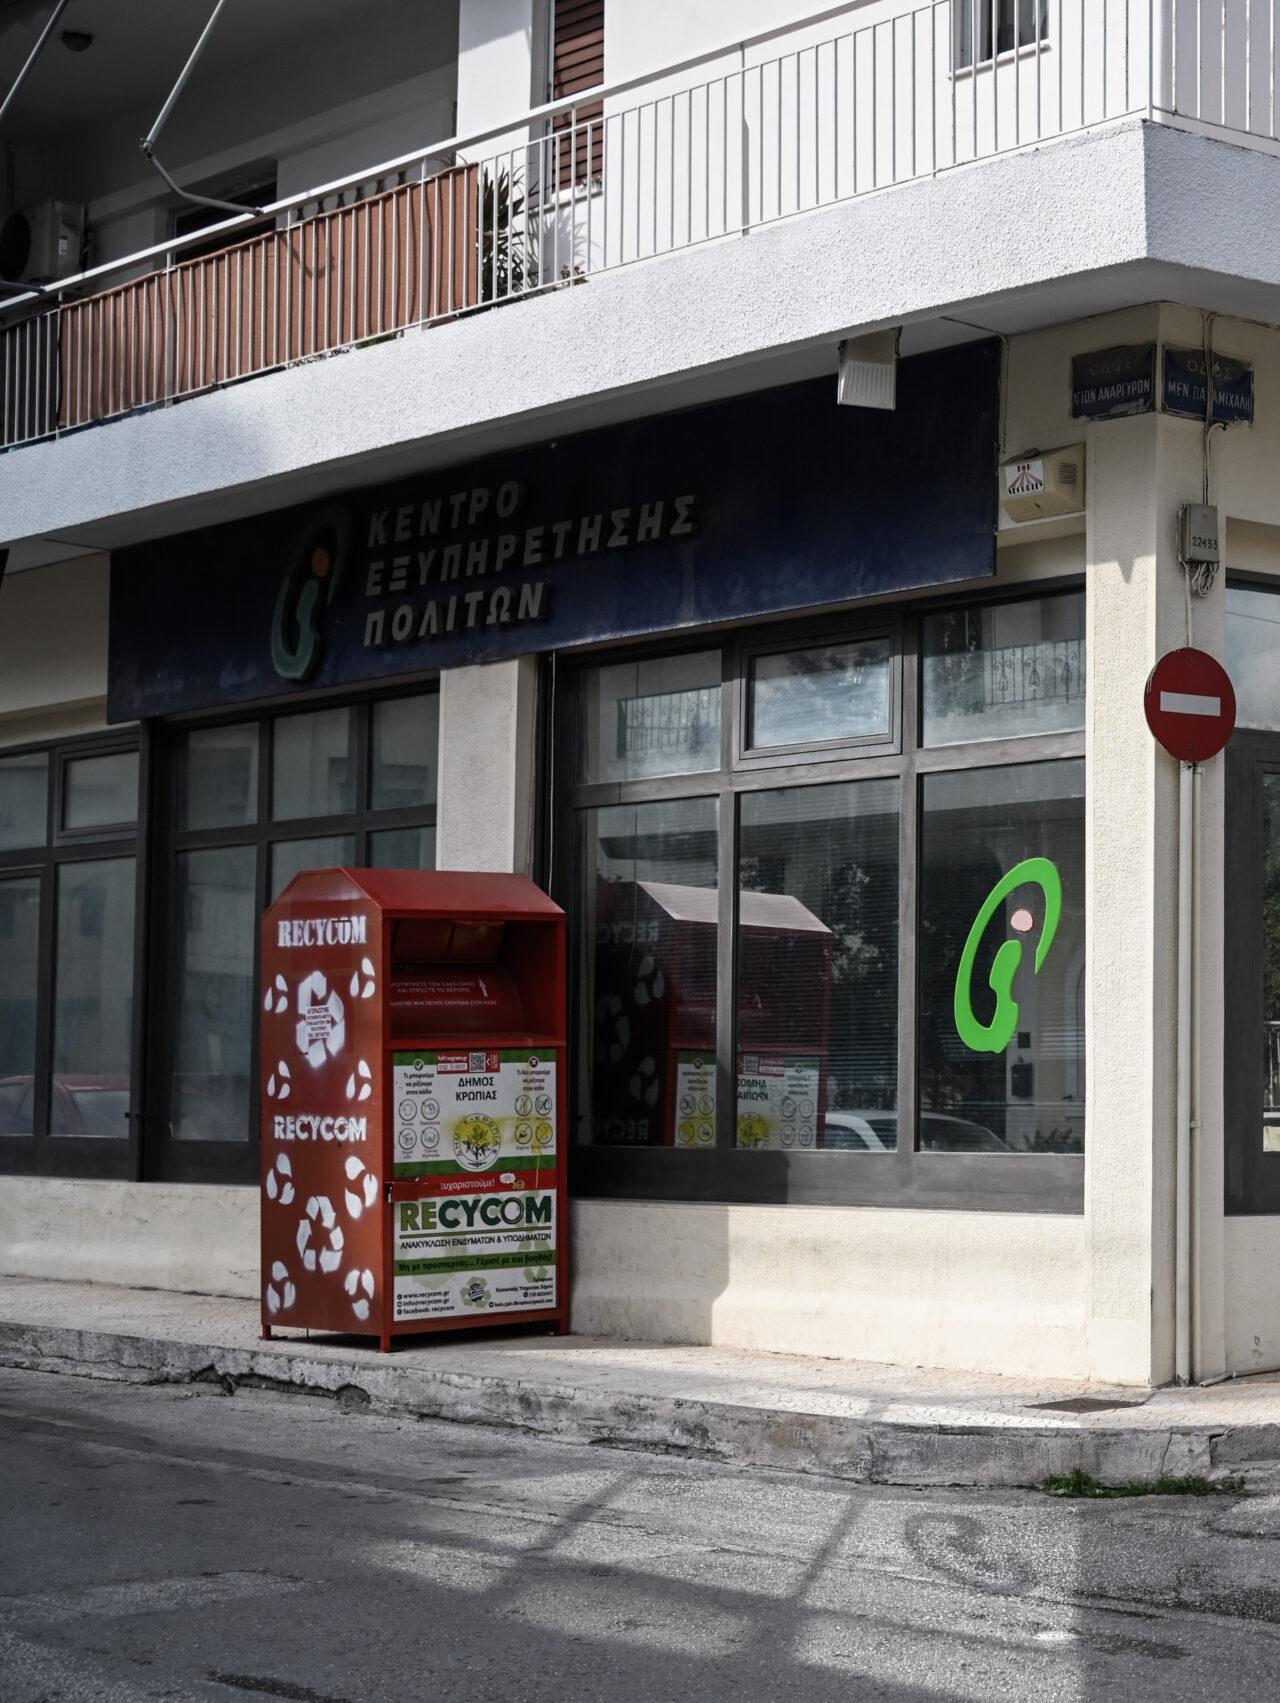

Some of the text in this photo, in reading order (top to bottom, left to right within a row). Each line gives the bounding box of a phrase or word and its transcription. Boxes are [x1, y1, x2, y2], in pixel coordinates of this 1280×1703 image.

[1098, 378, 1150, 401] ΑΝΑΡΓΥΡΩΝ
[1193, 385, 1250, 412] ΠΑΑΜΙΧΑΛΗ
[1008, 482, 1043, 495] SECURITY
[367, 480, 520, 548] ΚΕΝΤΡΟ
[365, 494, 696, 597] ΕΞΥΠΗΡΕΤΗΣΗΣ
[363, 581, 544, 647] ΠΟΛΙΤΩΝ
[277, 915, 367, 947] RECYCOM
[458, 1076, 495, 1088] ΔΗΜΟΣ
[456, 1090, 497, 1101] ΚΡΩΠΙΑΣ
[274, 1115, 367, 1142] RECYCOM
[400, 1195, 552, 1231] RECYCOM
[400, 1239, 451, 1249] ΑΝΑΚΥΚΛΩΣΗ
[452, 1236, 496, 1246] ΕΝΔΥΜΑΤΩΝ
[503, 1232, 552, 1243] ΥΠΟΔΗΜΑΤΩΝ
[399, 1263, 410, 1272] Μη
[403, 1290, 450, 1299] www.recycom.gr
[403, 1298, 450, 1307] info@recycom.gr
[403, 1305, 455, 1315] facebook: recycom
